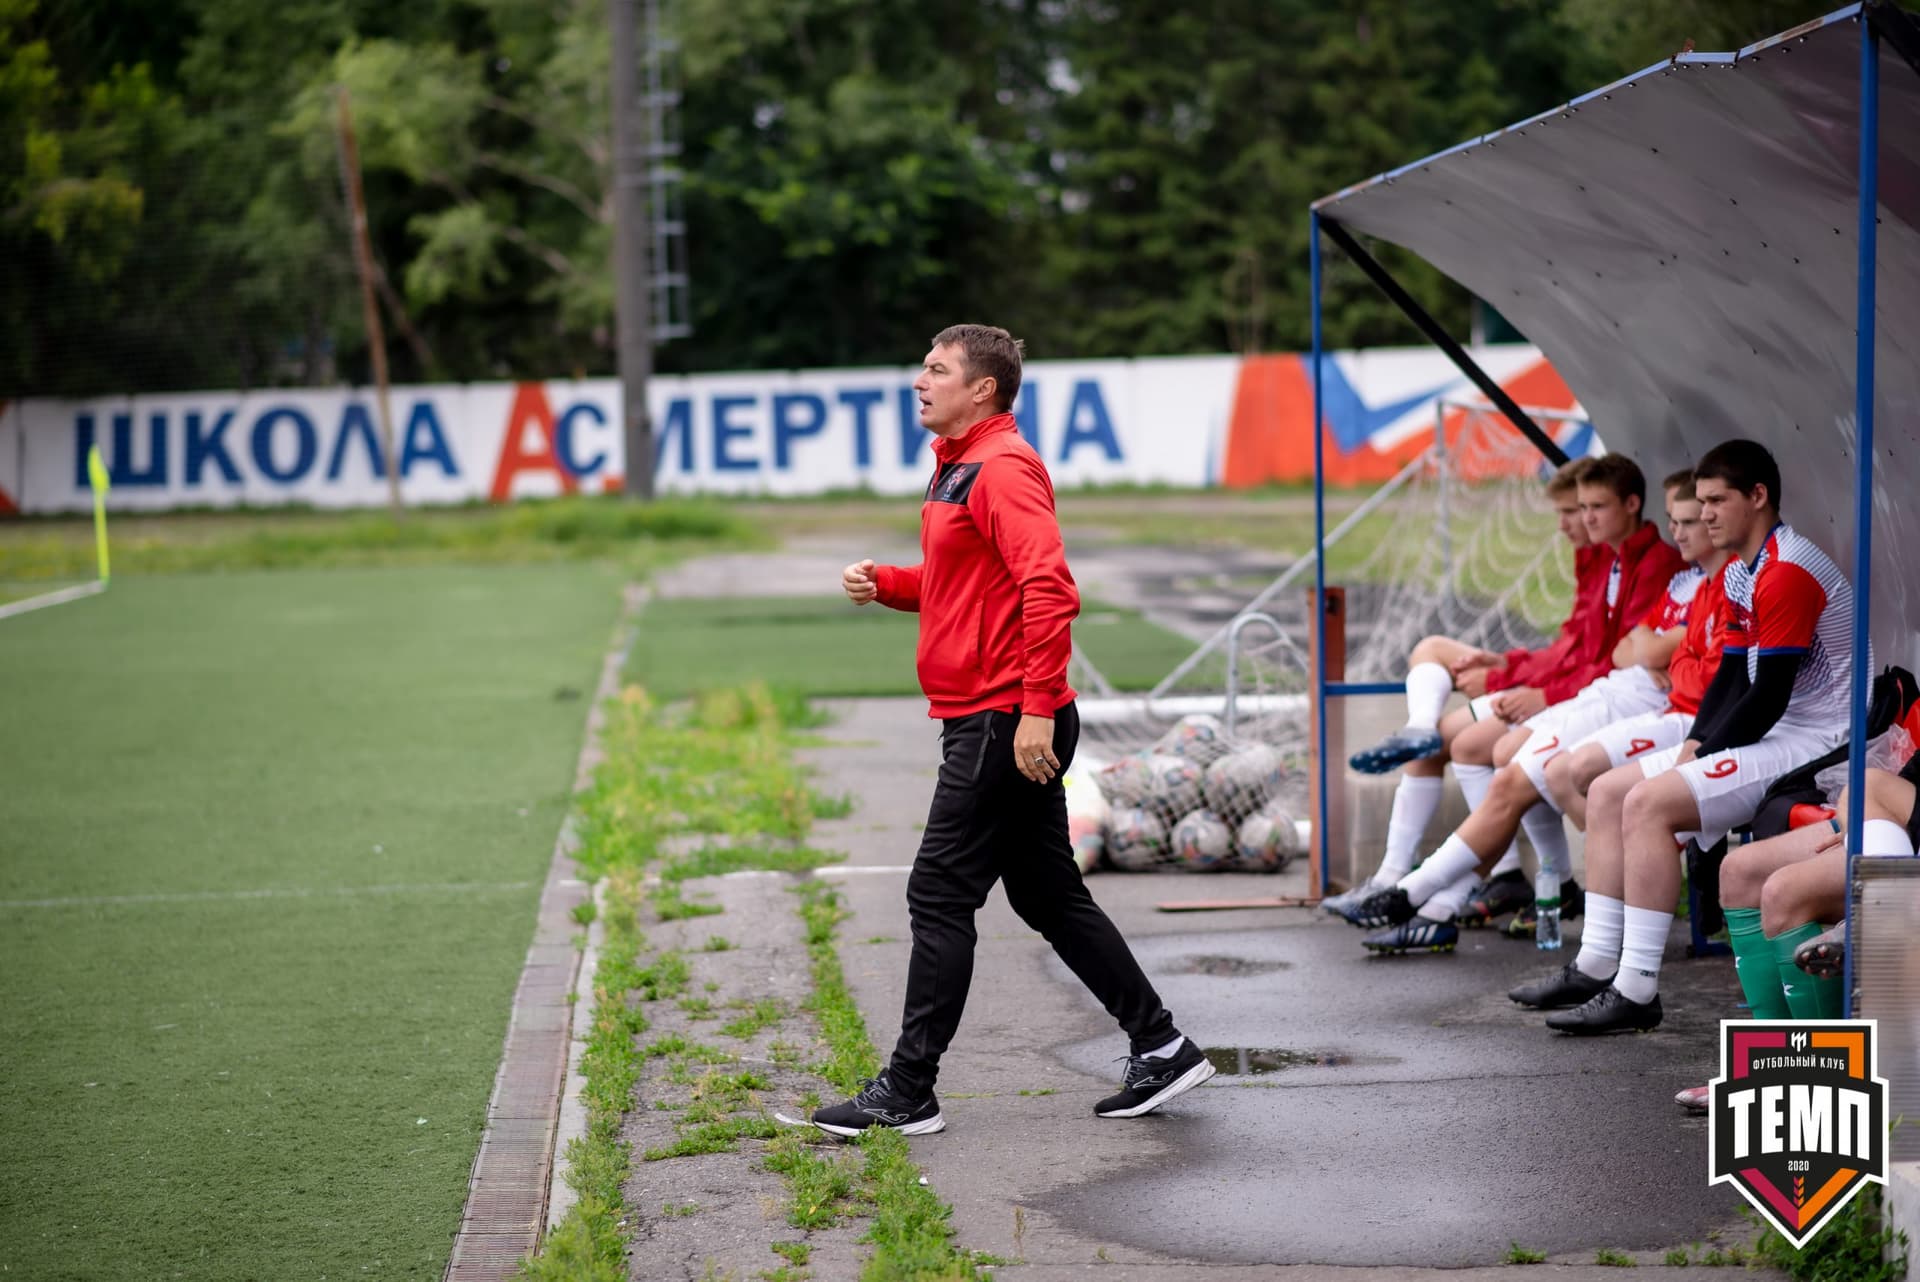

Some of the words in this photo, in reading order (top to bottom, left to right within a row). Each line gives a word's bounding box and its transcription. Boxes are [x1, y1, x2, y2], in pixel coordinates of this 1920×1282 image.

[75, 400, 459, 488] ШКОЛА
[1625, 738, 1656, 758] 4
[1703, 758, 1738, 778] 9
